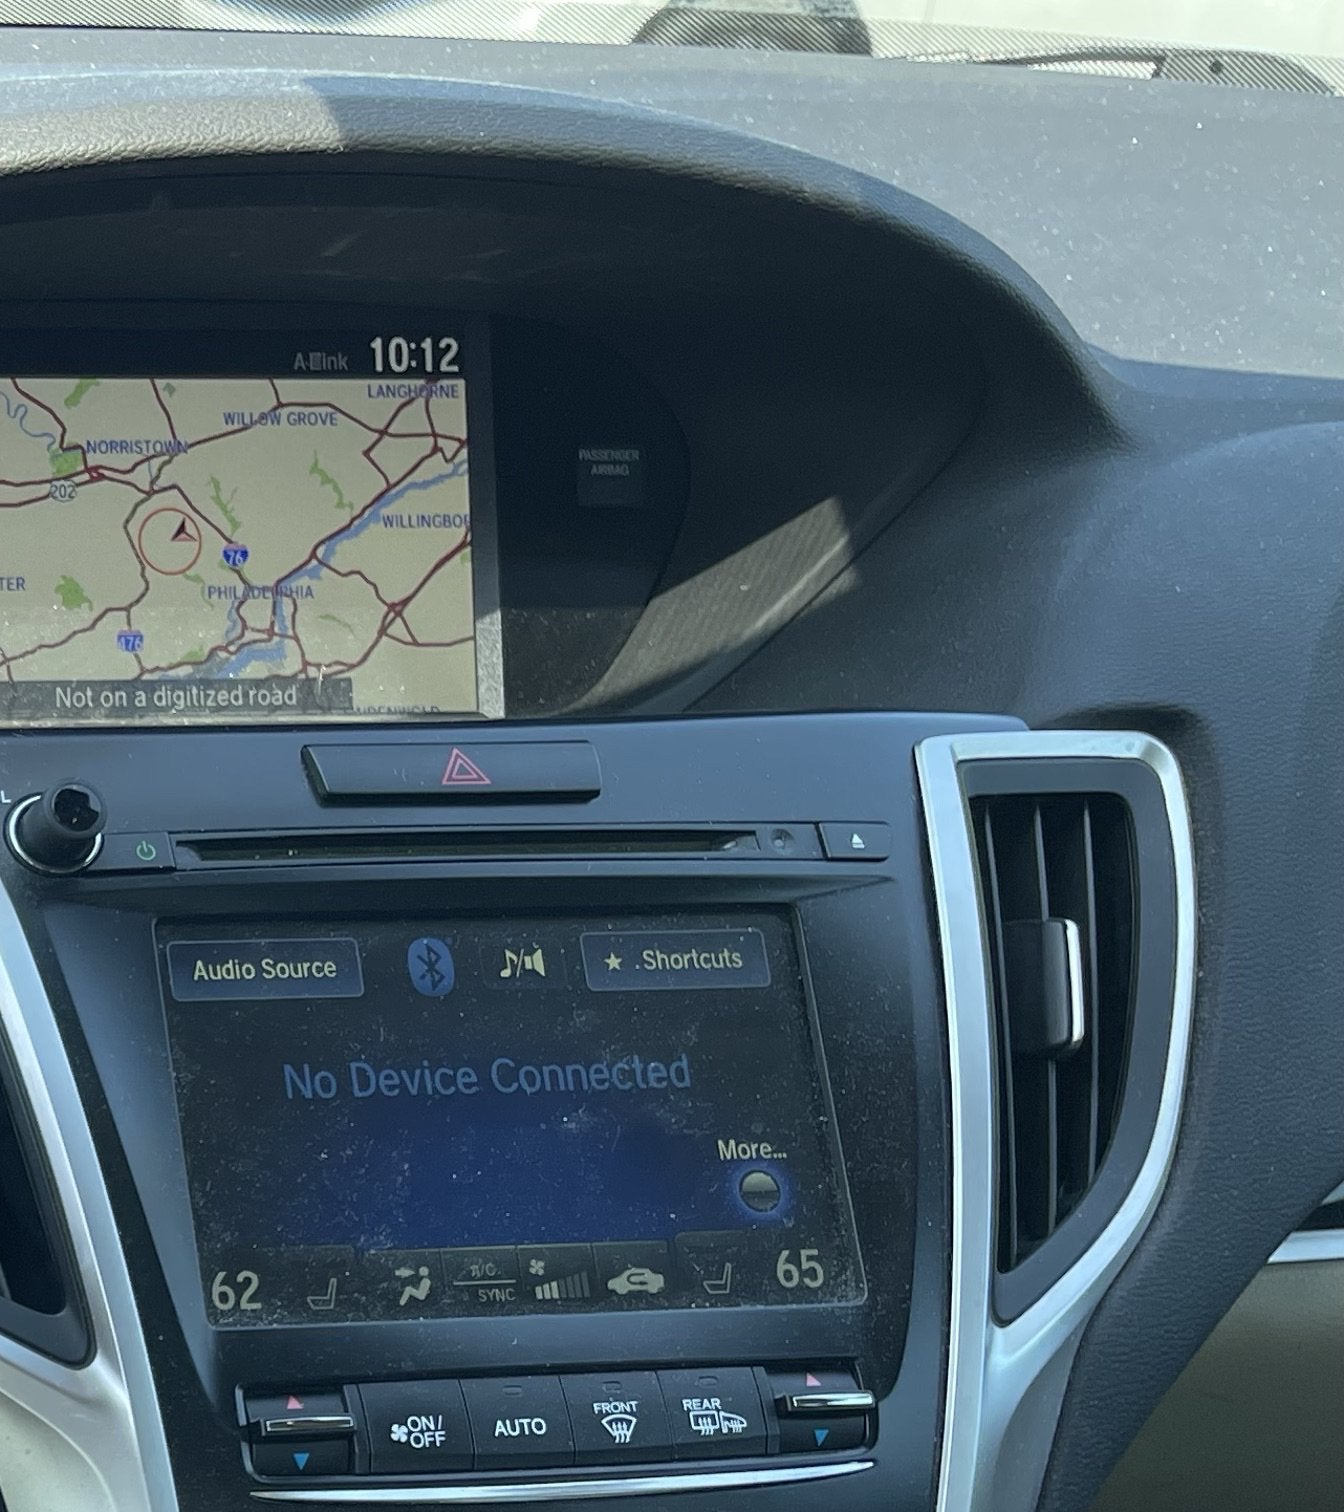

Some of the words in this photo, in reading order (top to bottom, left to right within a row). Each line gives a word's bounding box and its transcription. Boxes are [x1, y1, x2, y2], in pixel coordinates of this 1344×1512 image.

[370, 336, 460, 373] 10:12
[367, 384, 459, 399] LANGHORNE
[223, 412, 282, 427] WILLOW
[286, 412, 338, 427] GROVE
[86, 440, 188, 455] NORRISTOWN
[51, 484, 76, 499] 202
[56, 687, 94, 707] Not
[100, 691, 128, 707] on
[134, 691, 147, 706] a
[153, 685, 245, 709] digitized
[248, 685, 298, 706] road
[193, 956, 256, 982] Audio
[260, 955, 338, 981] Source
[642, 947, 744, 972] Shortcuts
[283, 1063, 337, 1100] No
[350, 1058, 478, 1098] Device
[490, 1053, 691, 1096] Connected
[775, 1248, 825, 1289] 65
[211, 1270, 262, 1312] 62
[478, 1288, 516, 1303] SYNC
[593, 1401, 638, 1416] FRONT
[682, 1397, 722, 1412] REAR
[494, 1417, 547, 1437] AUTO
[410, 1428, 447, 1449] OFF
